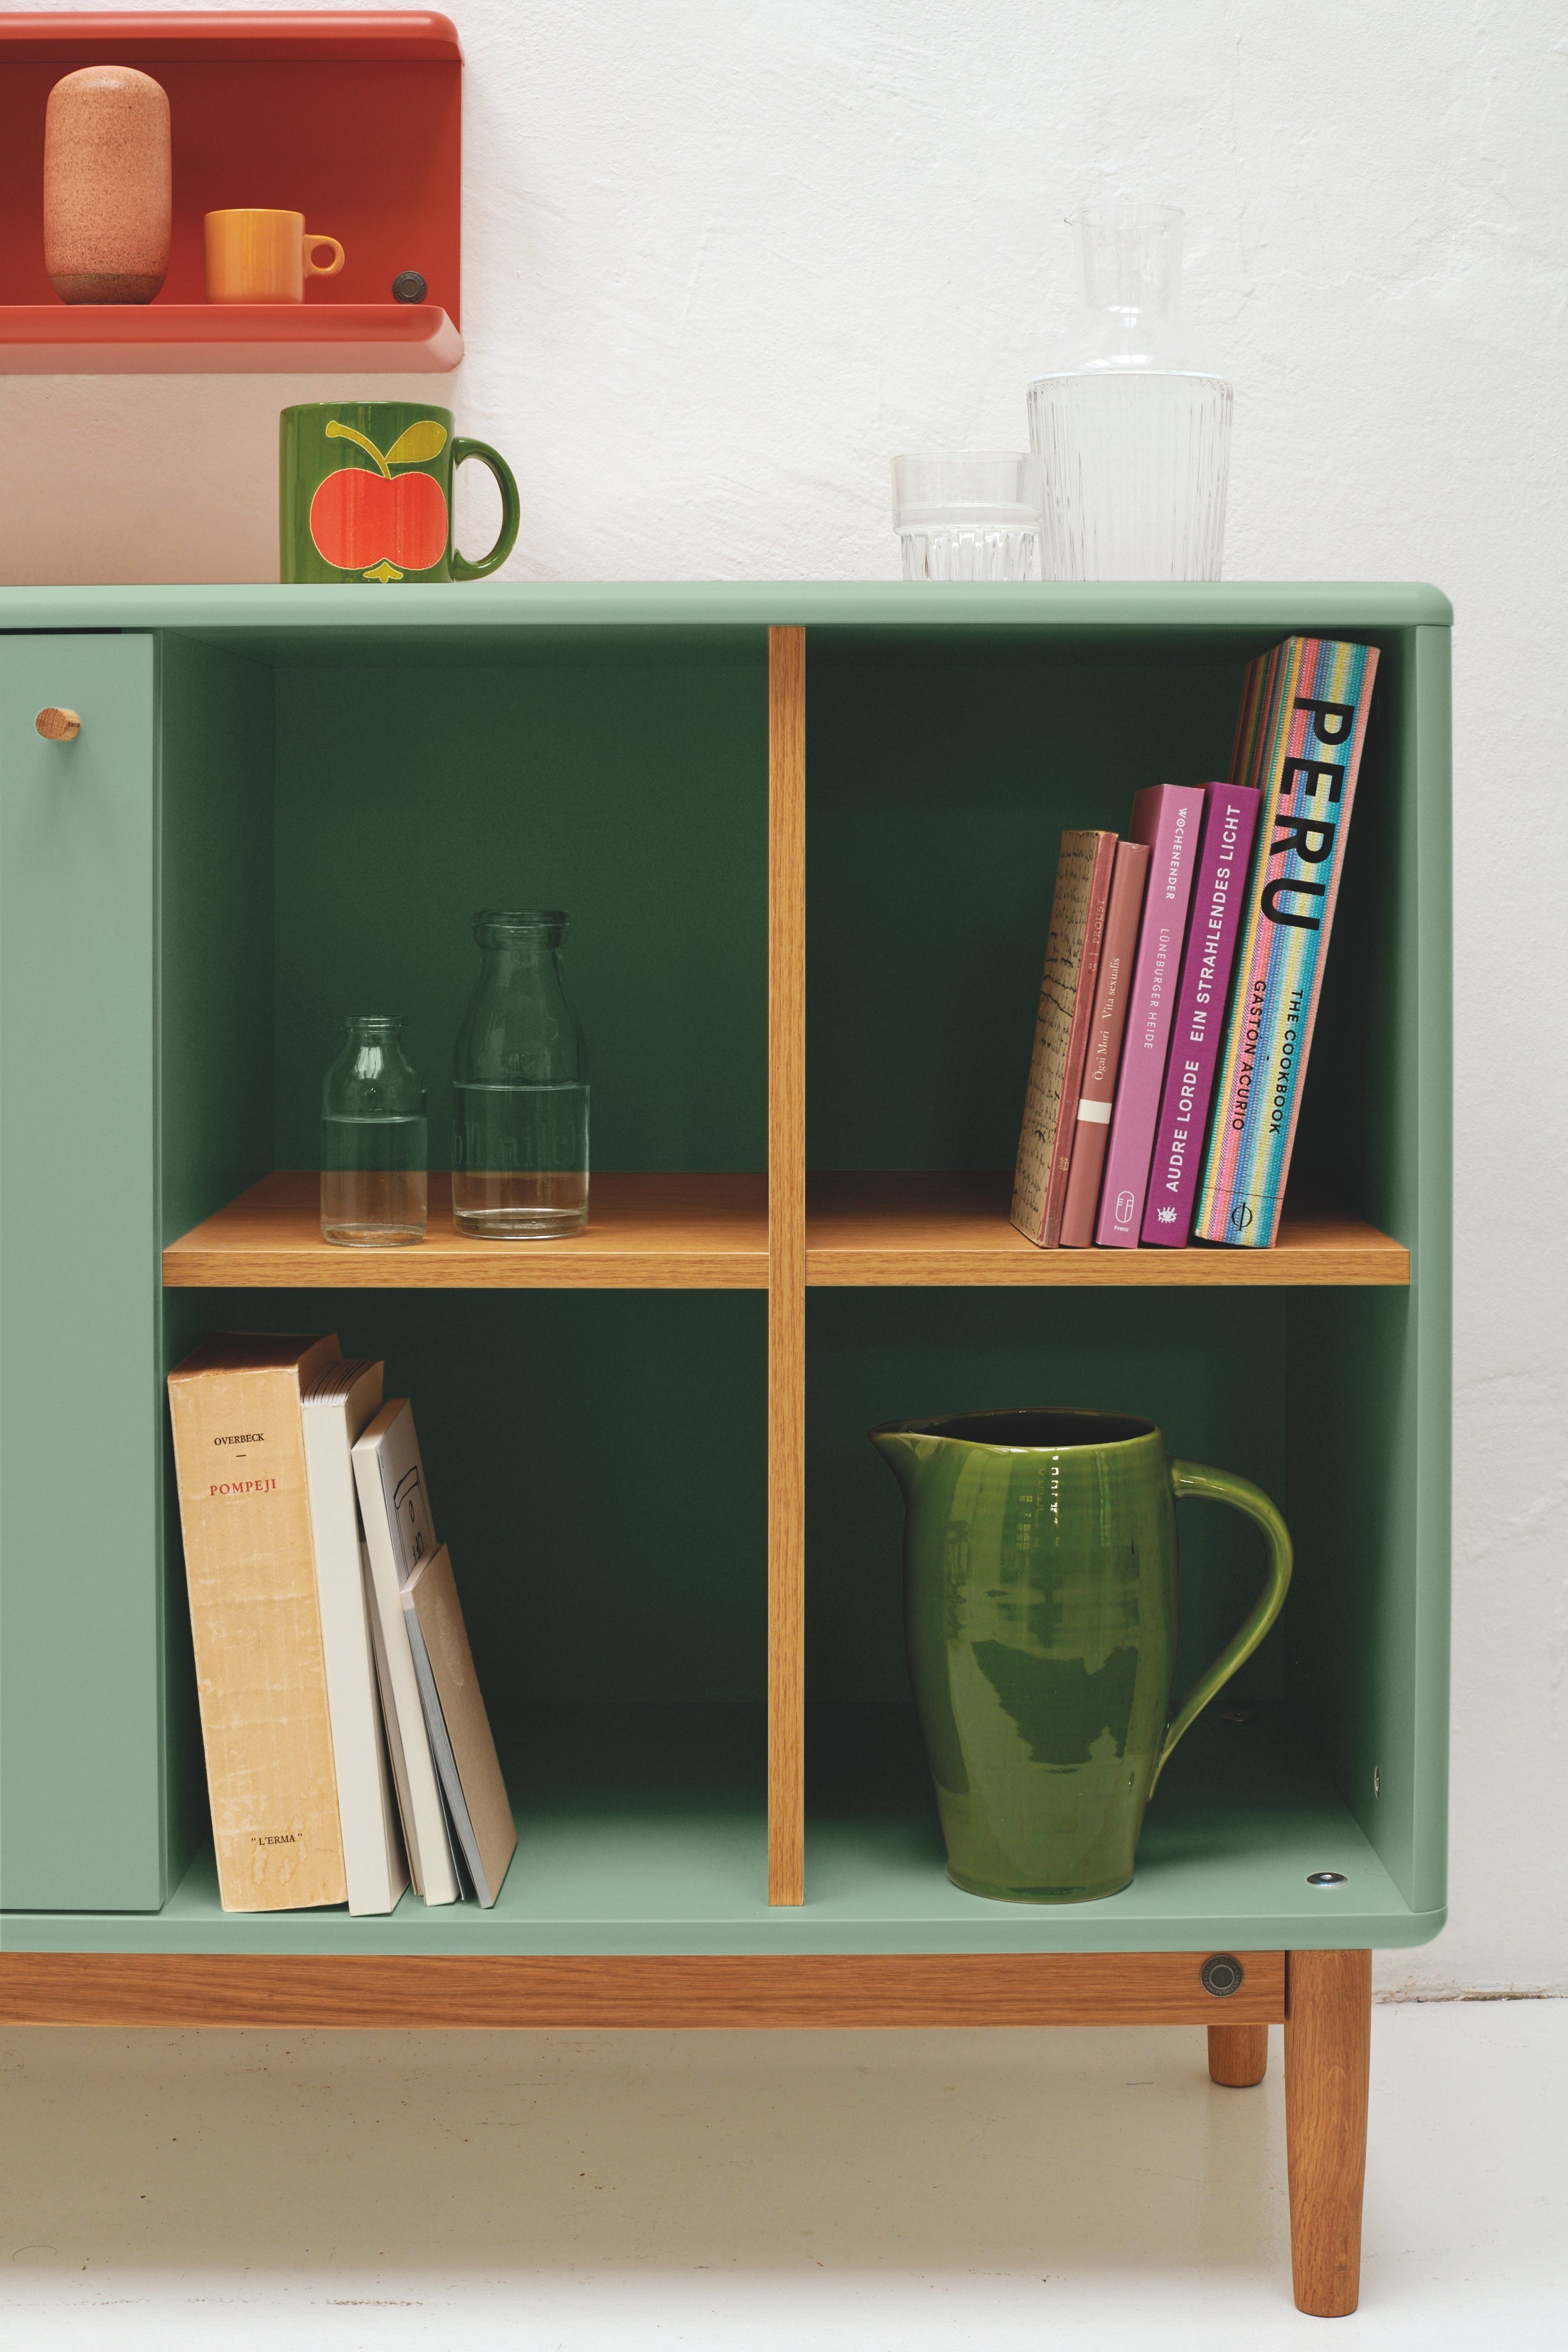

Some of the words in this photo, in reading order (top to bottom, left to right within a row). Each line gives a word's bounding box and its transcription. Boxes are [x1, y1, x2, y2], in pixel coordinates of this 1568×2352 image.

[1220, 804, 1241, 861] LICHT
[1261, 696, 1355, 931] PERU
[1166, 808, 1188, 900] WOCHENENDER
[1092, 899, 1105, 944] PROUST
[1196, 867, 1230, 1004] STRAHLENDES
[1102, 999, 1115, 1018] Vita
[1109, 958, 1120, 996] sexualis
[1150, 928, 1170, 1007] LÜNEBURGER
[1143, 1012, 1158, 1049] HEIDE
[1190, 1010, 1207, 1042] EIN
[1244, 980, 1266, 1055] GASTÓN
[1287, 989, 1303, 1023] THE
[1097, 1031, 1109, 1055] Mori
[1232, 1061, 1254, 1131] ACURIO
[1269, 1030, 1296, 1134] COOKBOOK
[1166, 1129, 1188, 1193] AUDRE
[1177, 1060, 1199, 1122] LORDE
[214, 1433, 265, 1445] OVERBECK
[209, 1479, 277, 1496] POMPEJI
